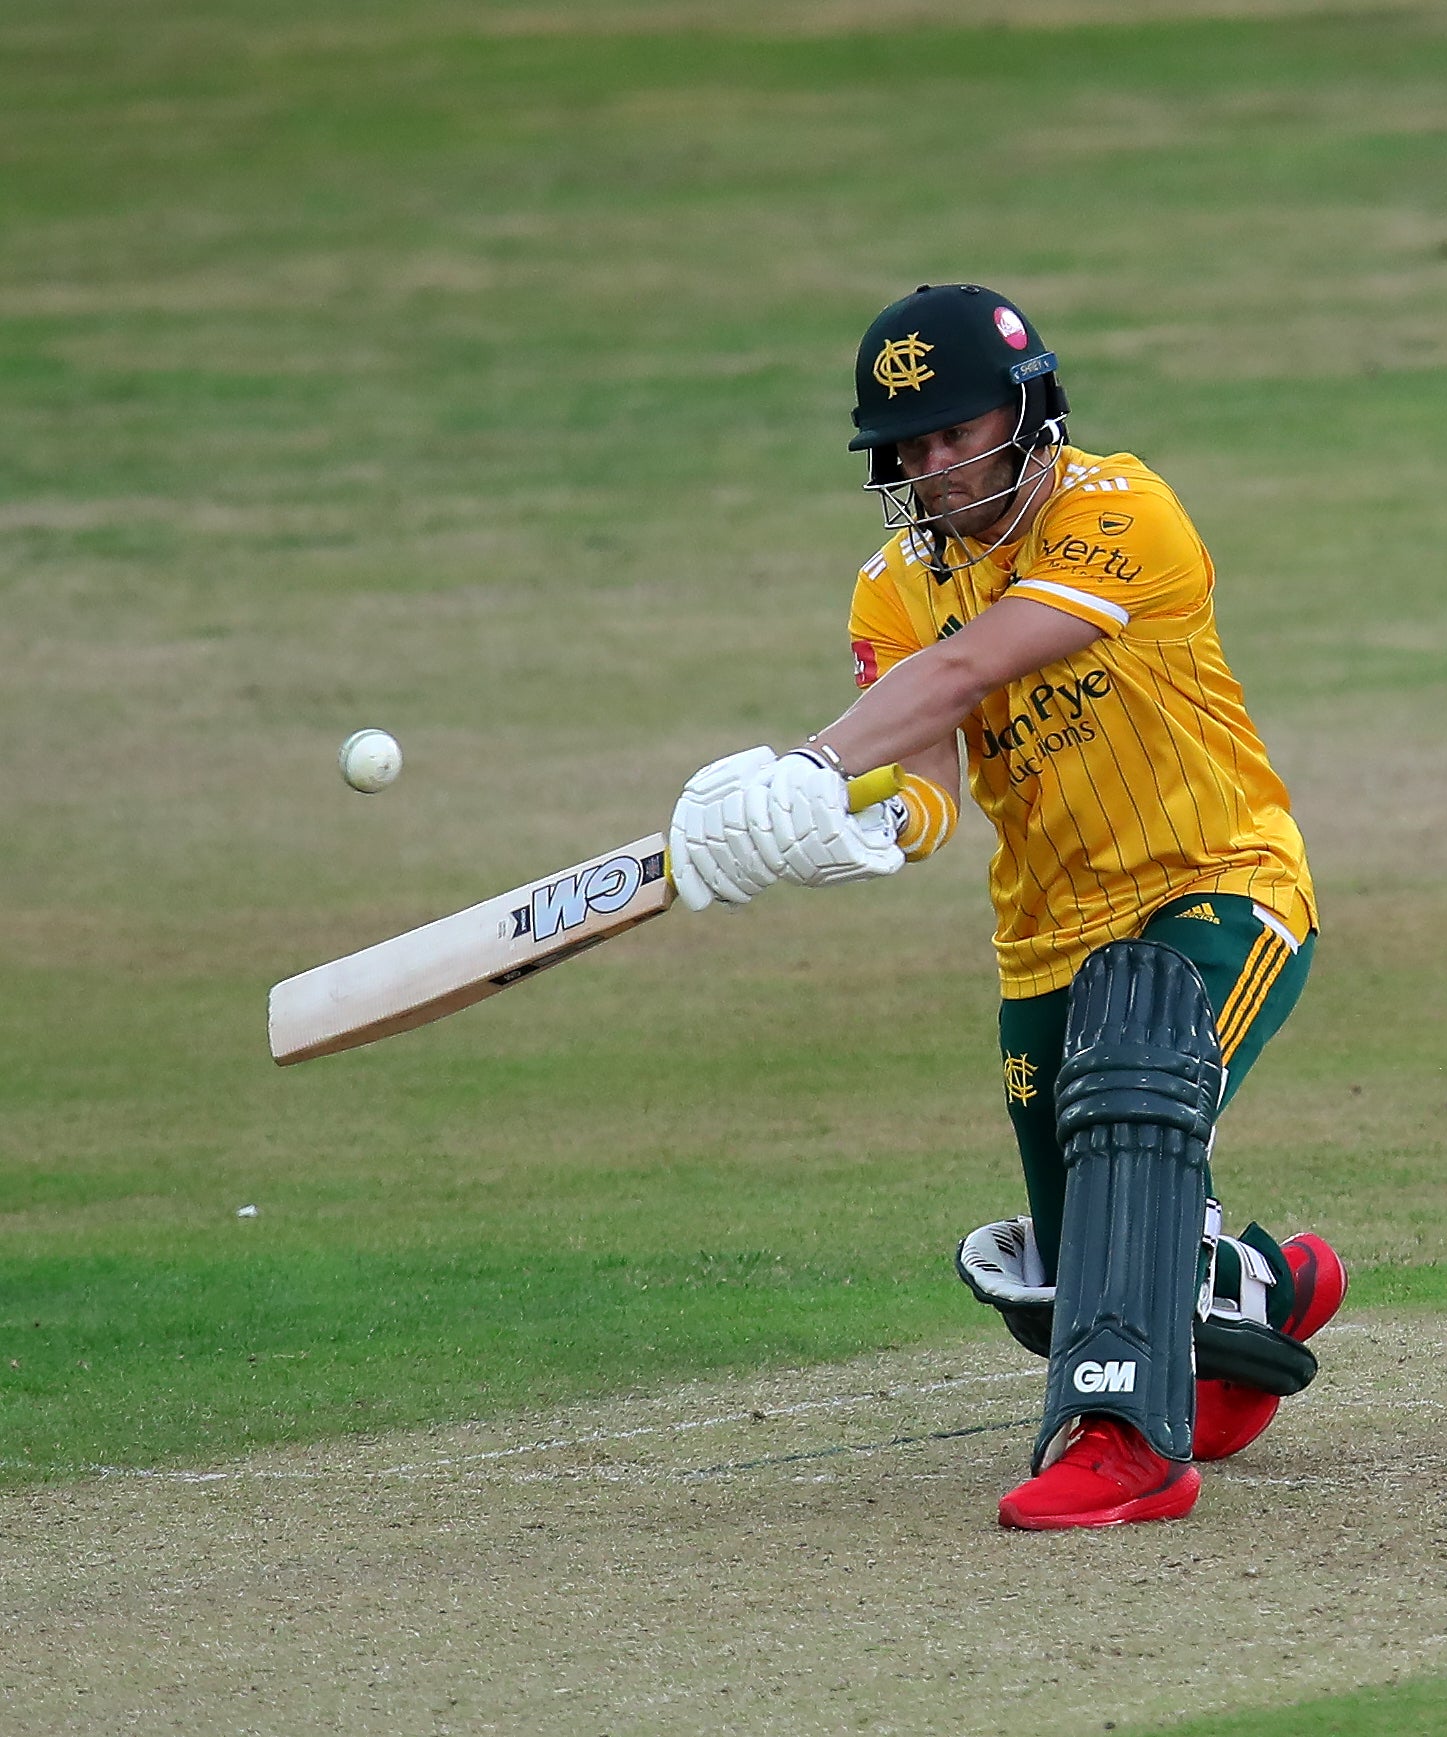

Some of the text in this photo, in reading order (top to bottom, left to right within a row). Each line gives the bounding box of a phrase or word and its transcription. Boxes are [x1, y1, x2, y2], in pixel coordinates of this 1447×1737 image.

[1043, 534, 1142, 583] vertu
[1030, 670, 1112, 720] Pye
[532, 855, 642, 942] GM
[1073, 1360, 1137, 1394] GM
